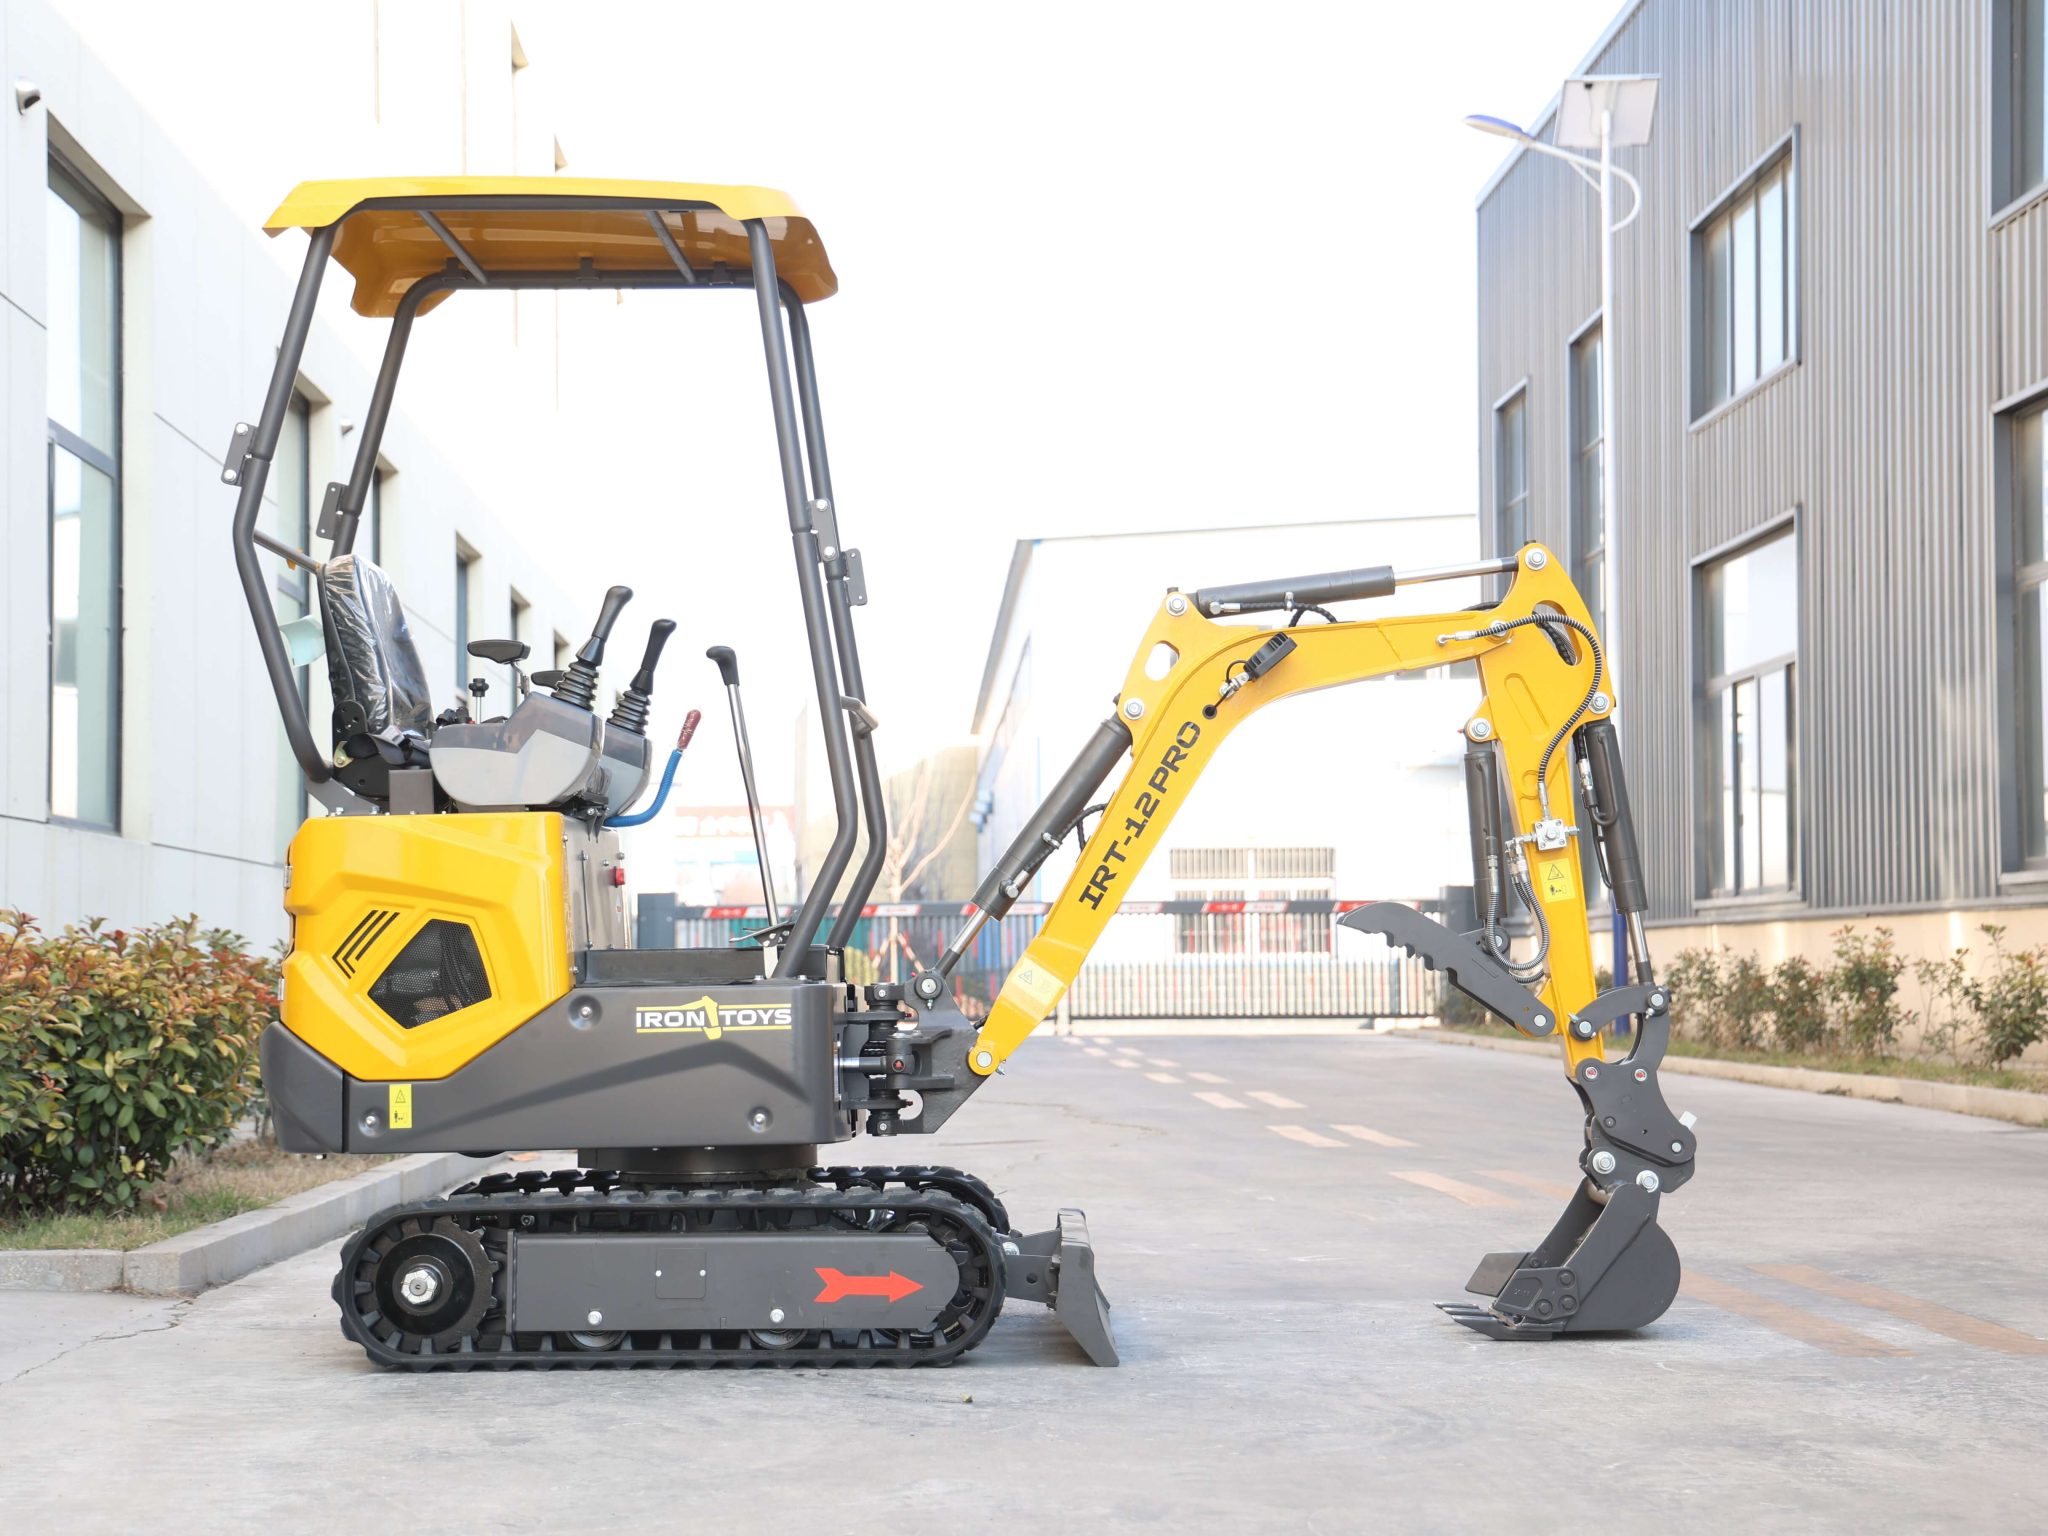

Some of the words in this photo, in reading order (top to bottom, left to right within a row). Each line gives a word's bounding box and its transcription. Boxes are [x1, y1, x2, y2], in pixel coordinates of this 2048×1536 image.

[1147, 721, 1201, 794] PRO
[635, 1010, 705, 1028] IRON
[718, 1008, 793, 1026] TOYS
